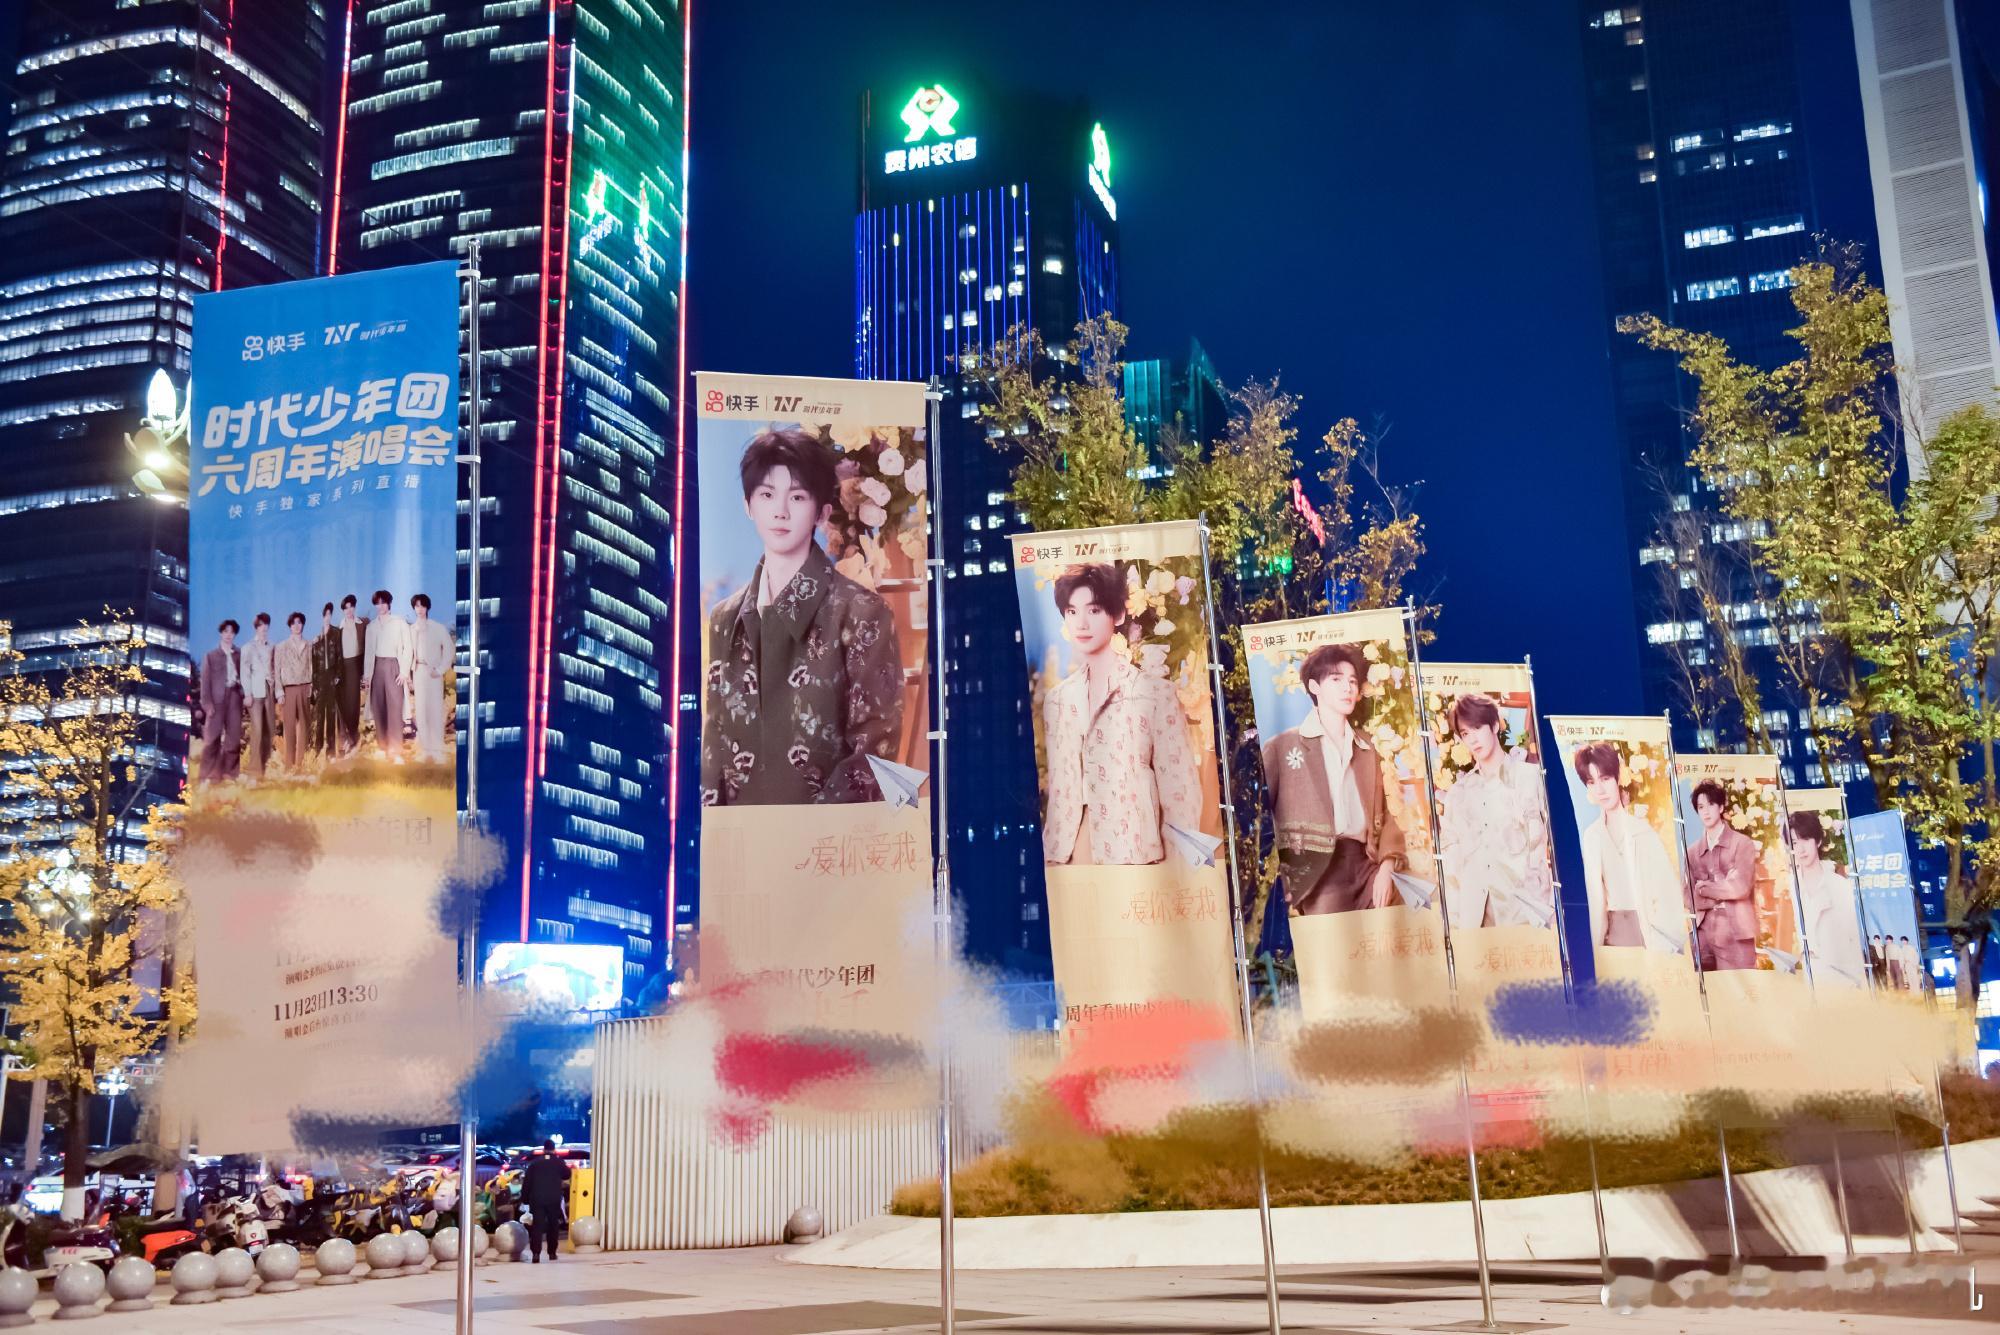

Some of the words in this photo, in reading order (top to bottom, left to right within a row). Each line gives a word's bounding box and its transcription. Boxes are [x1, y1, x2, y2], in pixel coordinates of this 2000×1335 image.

[266, 331, 306, 356] 快手
[202, 372, 451, 449] 时代少年团
[726, 394, 760, 412] 快手
[197, 424, 454, 497] 六周年演唱会
[1036, 546, 1064, 560] 快手
[1263, 634, 1288, 648] 快手
